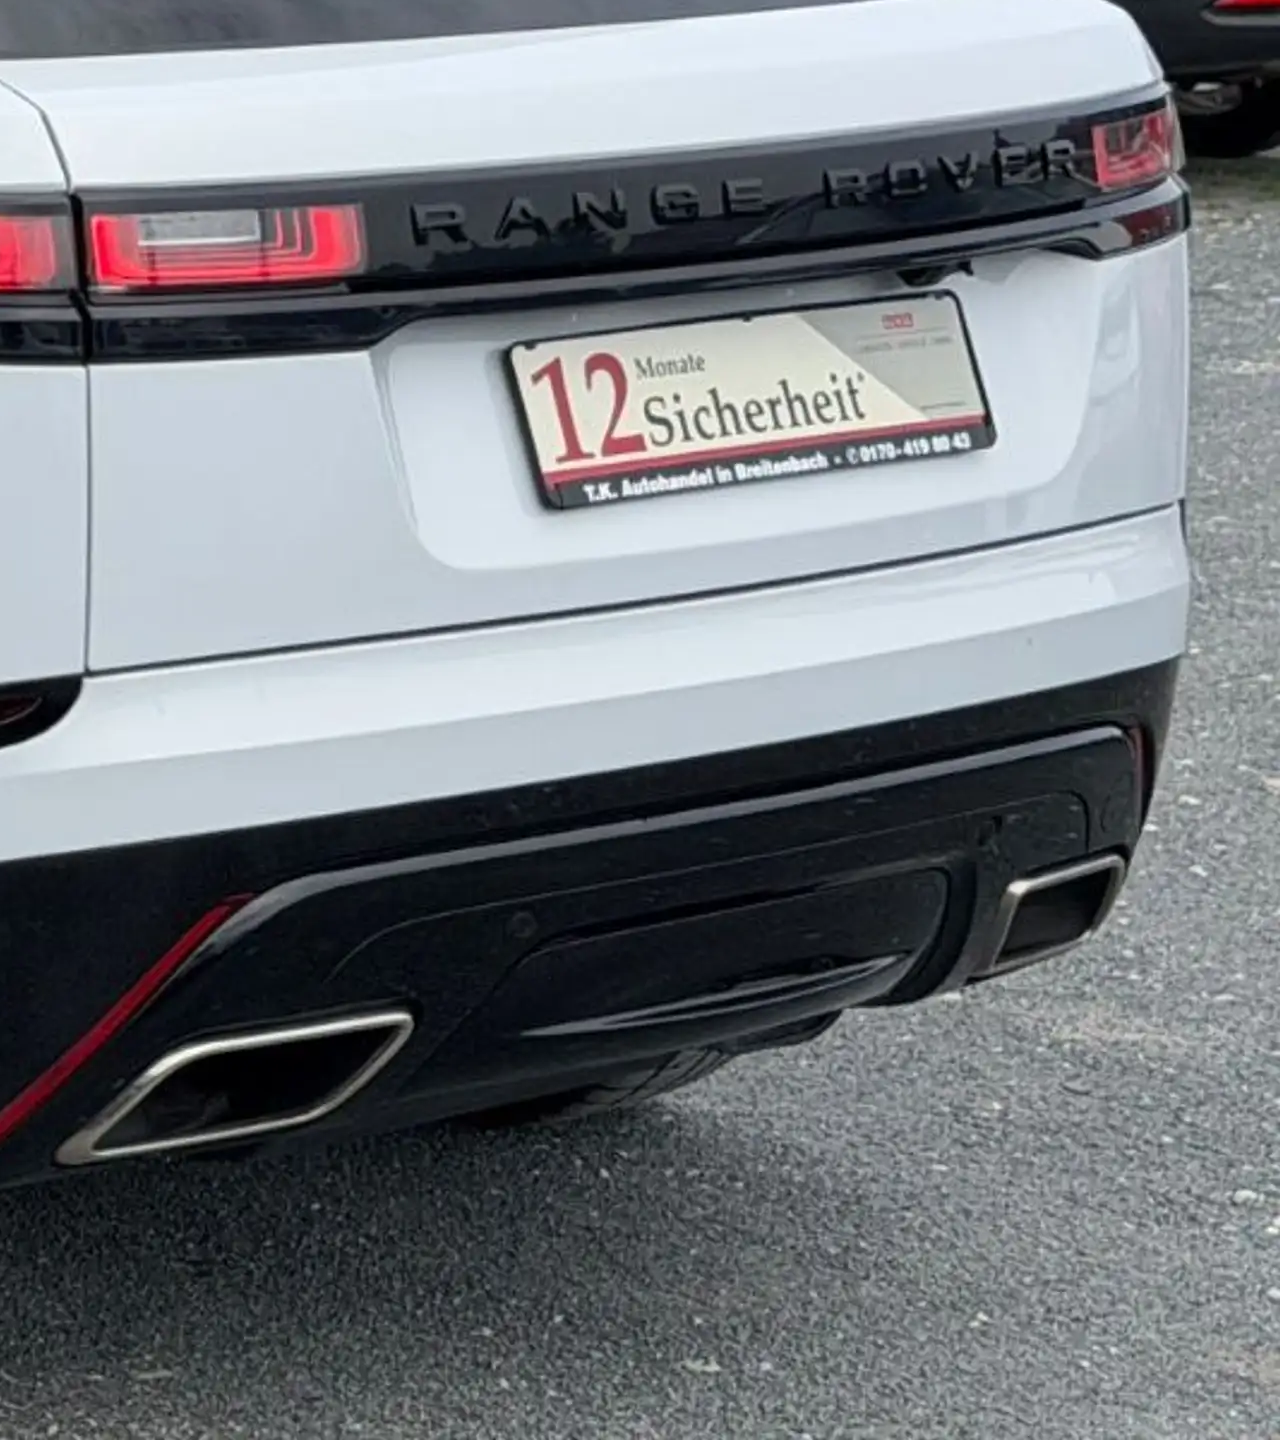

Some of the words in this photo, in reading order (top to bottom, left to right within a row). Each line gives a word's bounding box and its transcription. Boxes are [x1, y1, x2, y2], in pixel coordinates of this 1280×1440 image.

[411, 178, 765, 246] RANGE
[823, 138, 1077, 209] ROVER
[634, 353, 706, 380] Monate
[530, 352, 648, 464] 12
[582, 481, 619, 503] T.K.
[622, 466, 714, 497] Autohandel
[715, 464, 734, 484] in
